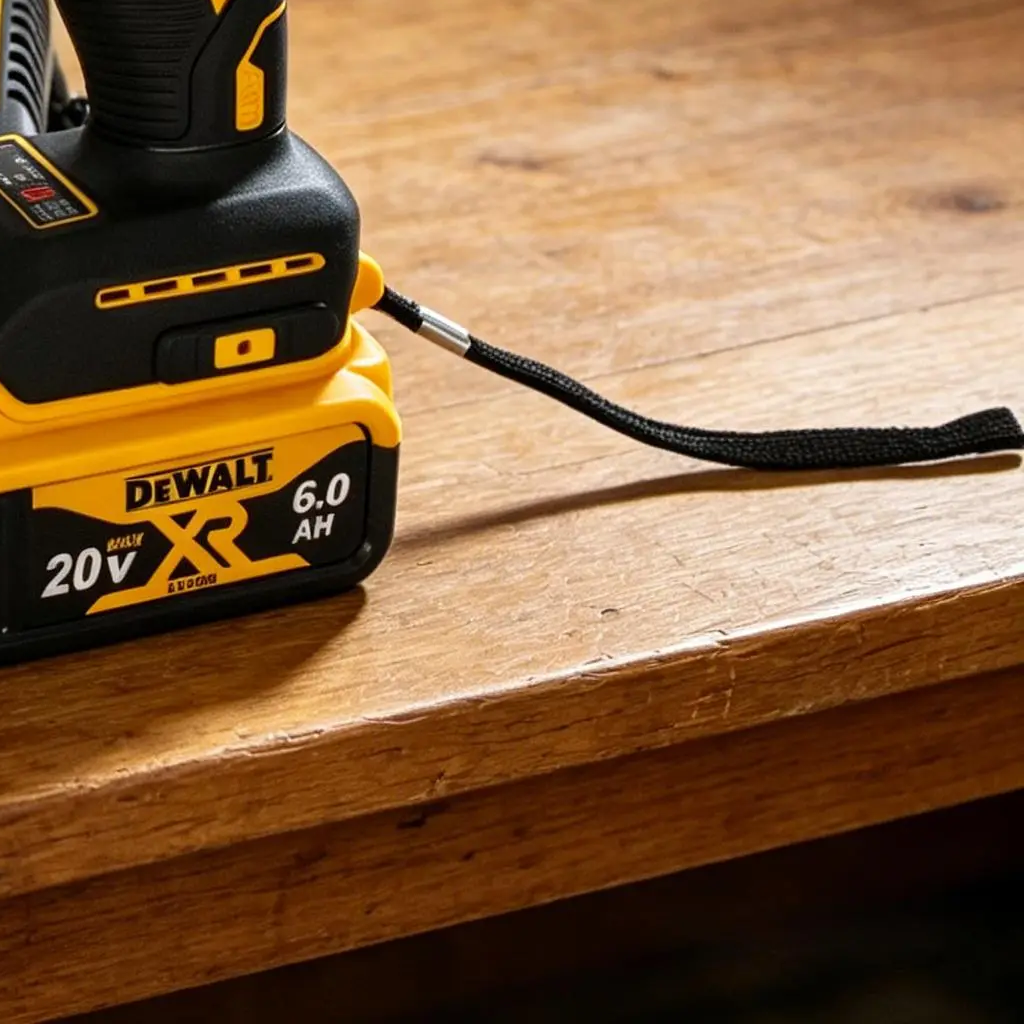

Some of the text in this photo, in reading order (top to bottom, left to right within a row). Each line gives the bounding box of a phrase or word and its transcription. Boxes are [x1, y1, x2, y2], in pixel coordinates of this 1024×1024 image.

[292, 473, 350, 514] 6.0
[144, 500, 254, 588] XR
[292, 513, 335, 545] AH
